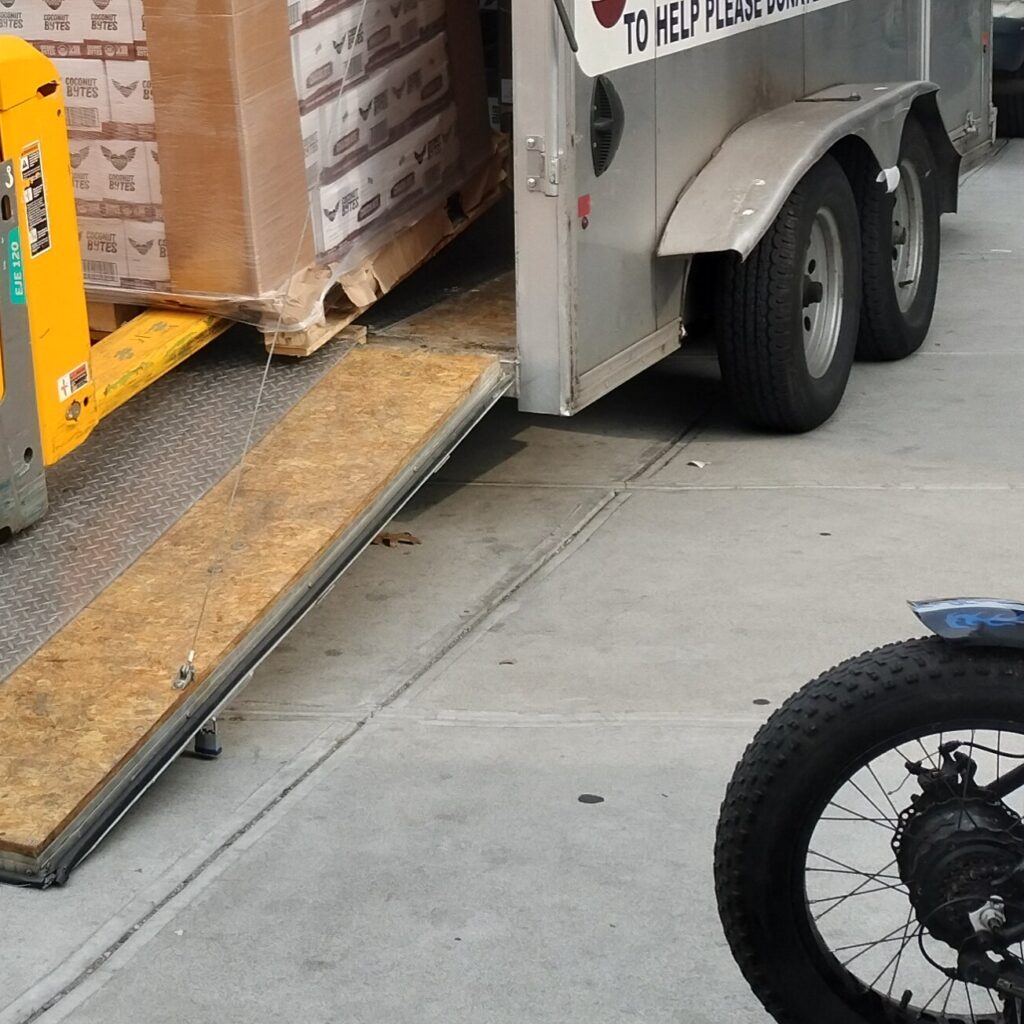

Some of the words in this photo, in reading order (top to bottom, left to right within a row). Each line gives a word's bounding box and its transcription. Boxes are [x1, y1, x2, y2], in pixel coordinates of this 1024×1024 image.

[44, 21, 71, 31] BYTES
[91, 21, 118, 31] BYTES
[624, 9, 649, 54] TO
[67, 86, 98, 98] BYTES
[109, 181, 136, 192] BYTES
[88, 241, 118, 254] BYTES
[10, 242, 22, 268] 120
[14, 272, 24, 296] EJE
